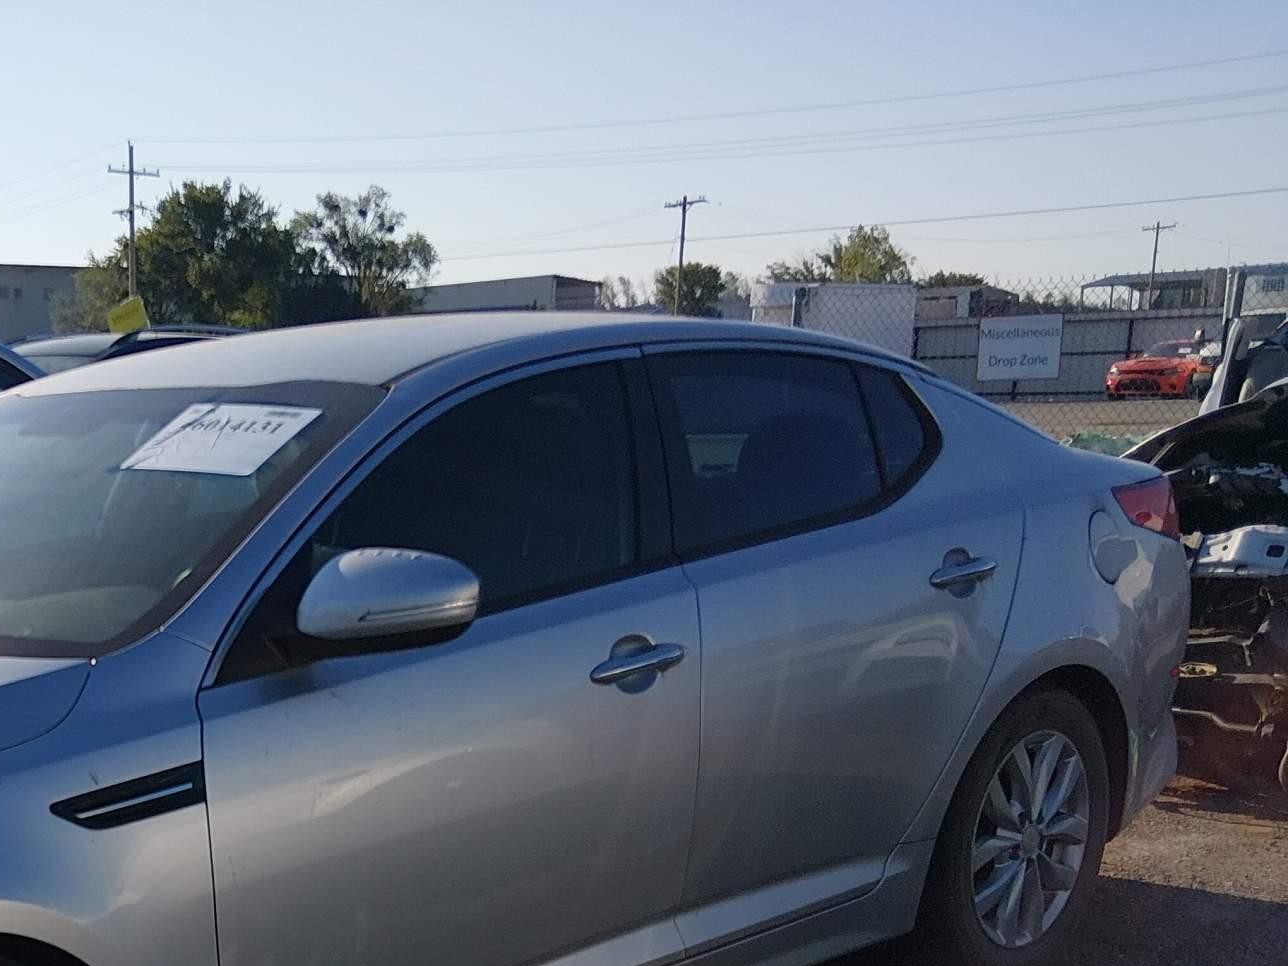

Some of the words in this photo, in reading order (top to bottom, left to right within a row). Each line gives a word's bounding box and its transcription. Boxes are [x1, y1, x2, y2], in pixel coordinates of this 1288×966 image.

[981, 327, 1060, 340] Miscellaneous
[988, 354, 1017, 368] Drop
[1019, 353, 1049, 366] Zone
